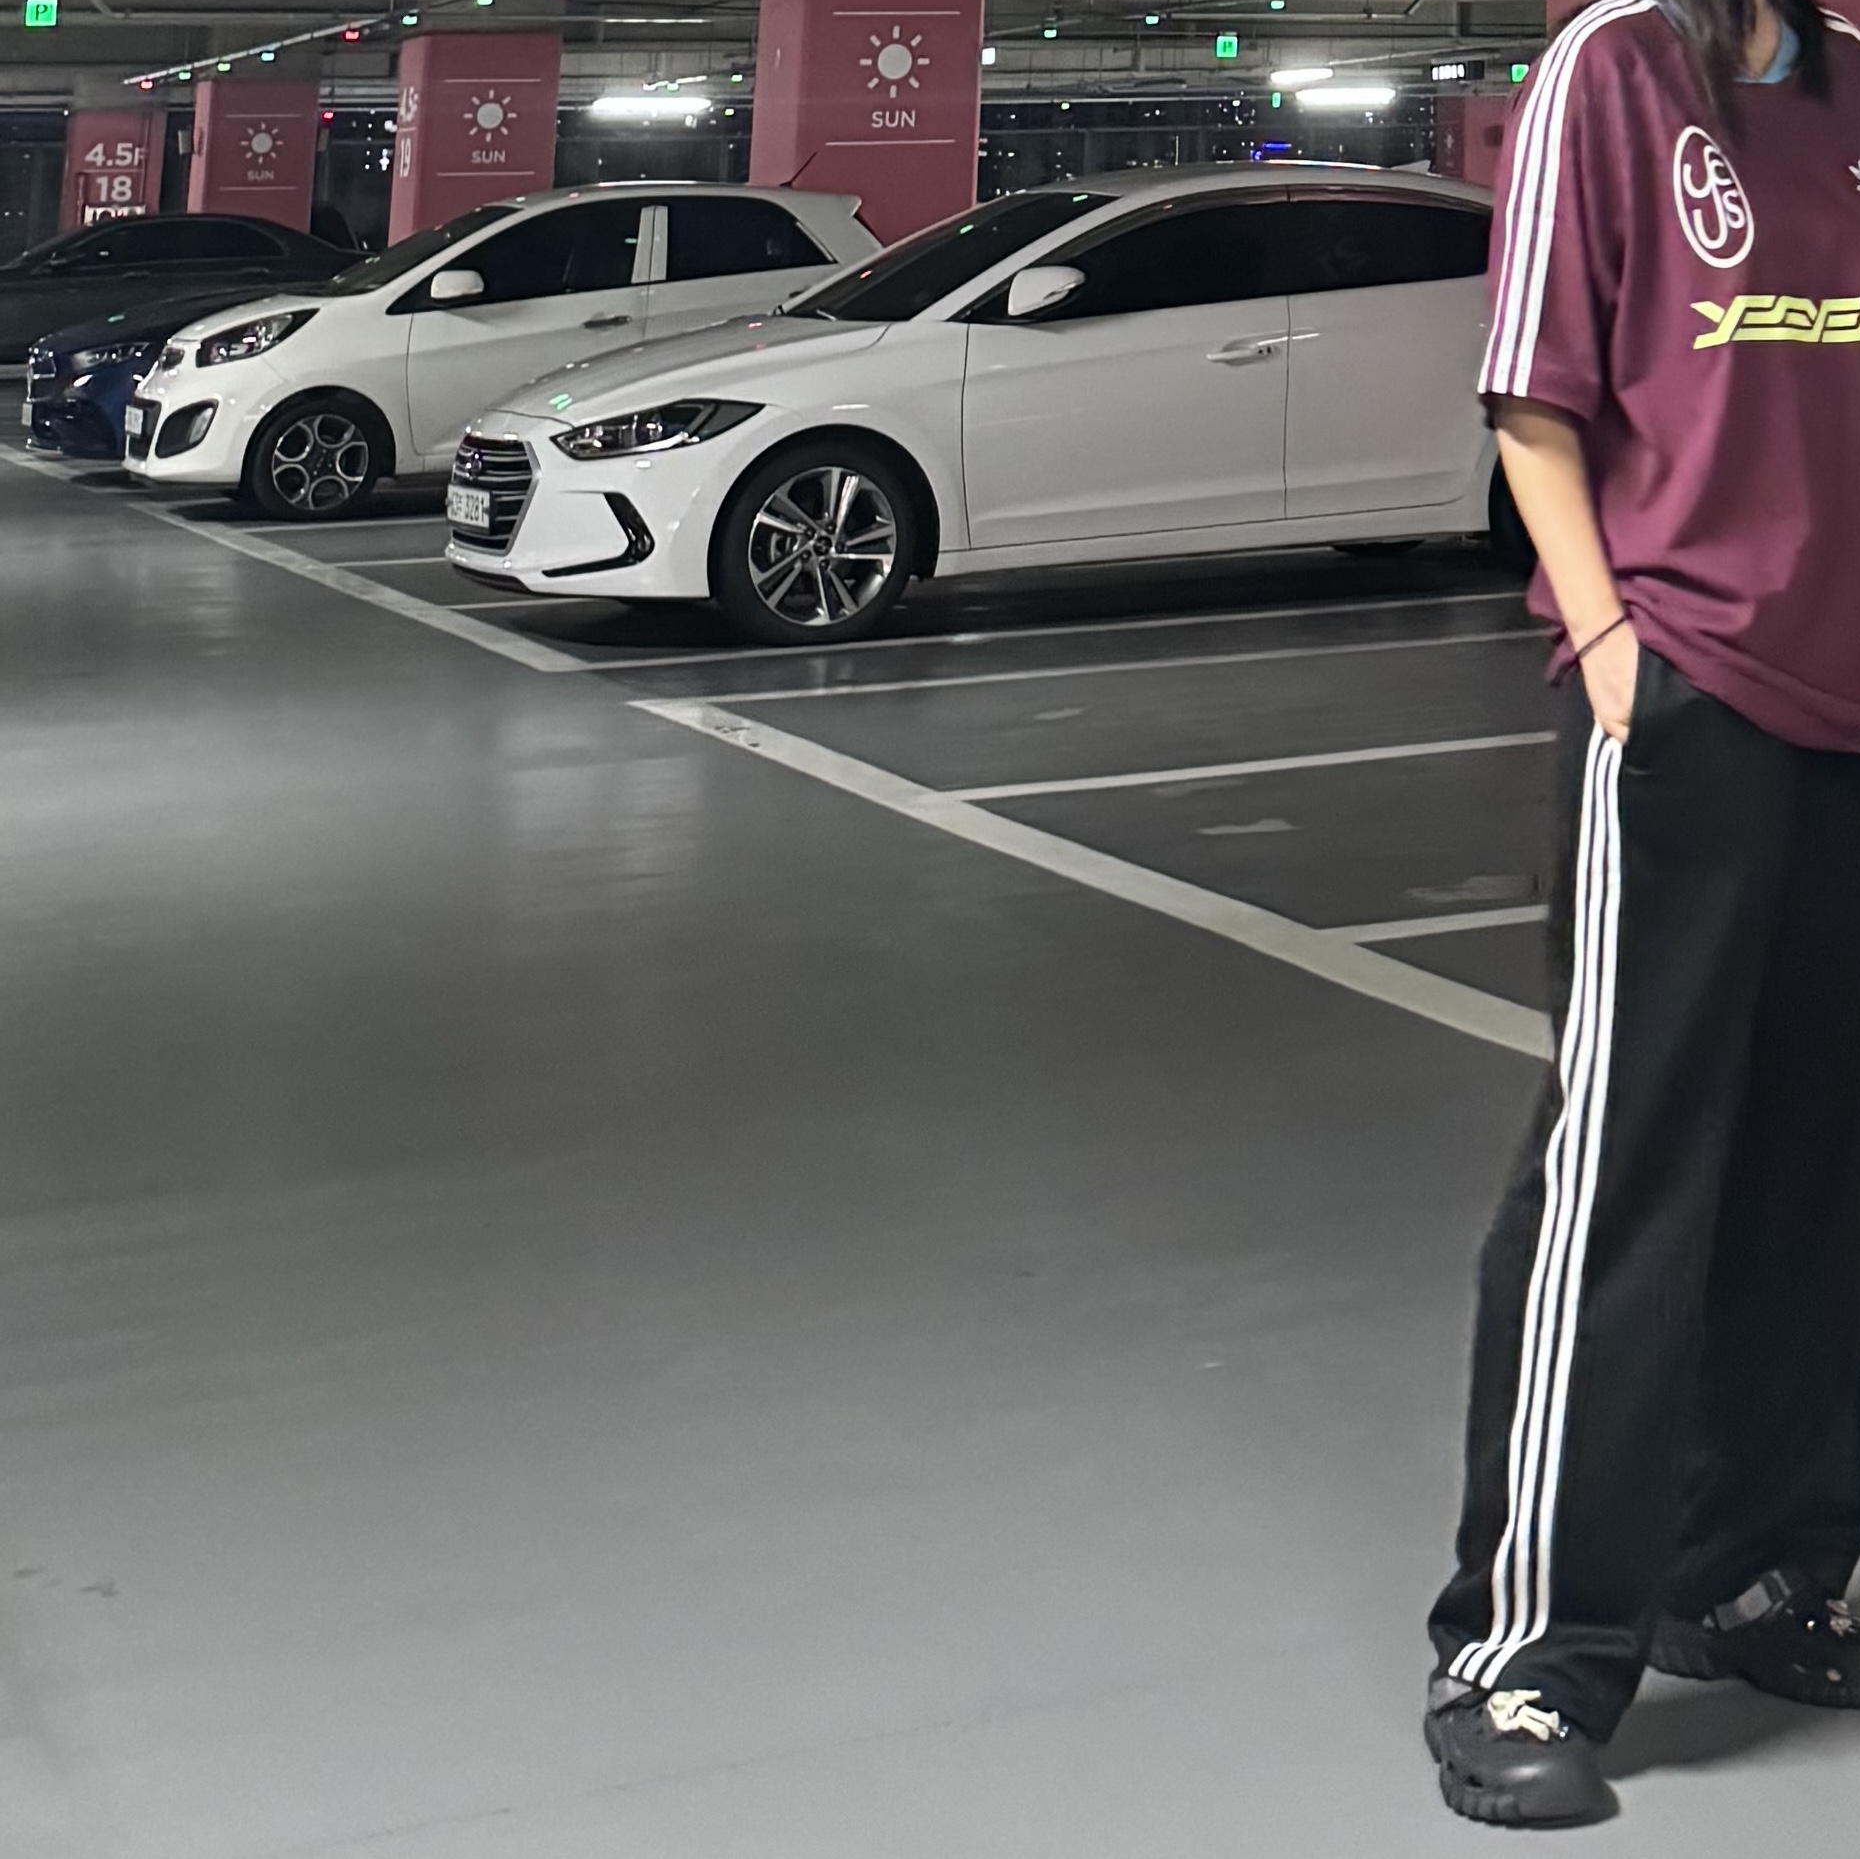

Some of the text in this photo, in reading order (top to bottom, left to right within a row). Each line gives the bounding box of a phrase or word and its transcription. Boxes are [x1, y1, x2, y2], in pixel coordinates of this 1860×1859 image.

[35, 3, 49, 21] P
[871, 109, 916, 128] SUN
[471, 149, 506, 164] SUN
[96, 175, 133, 203] 18
